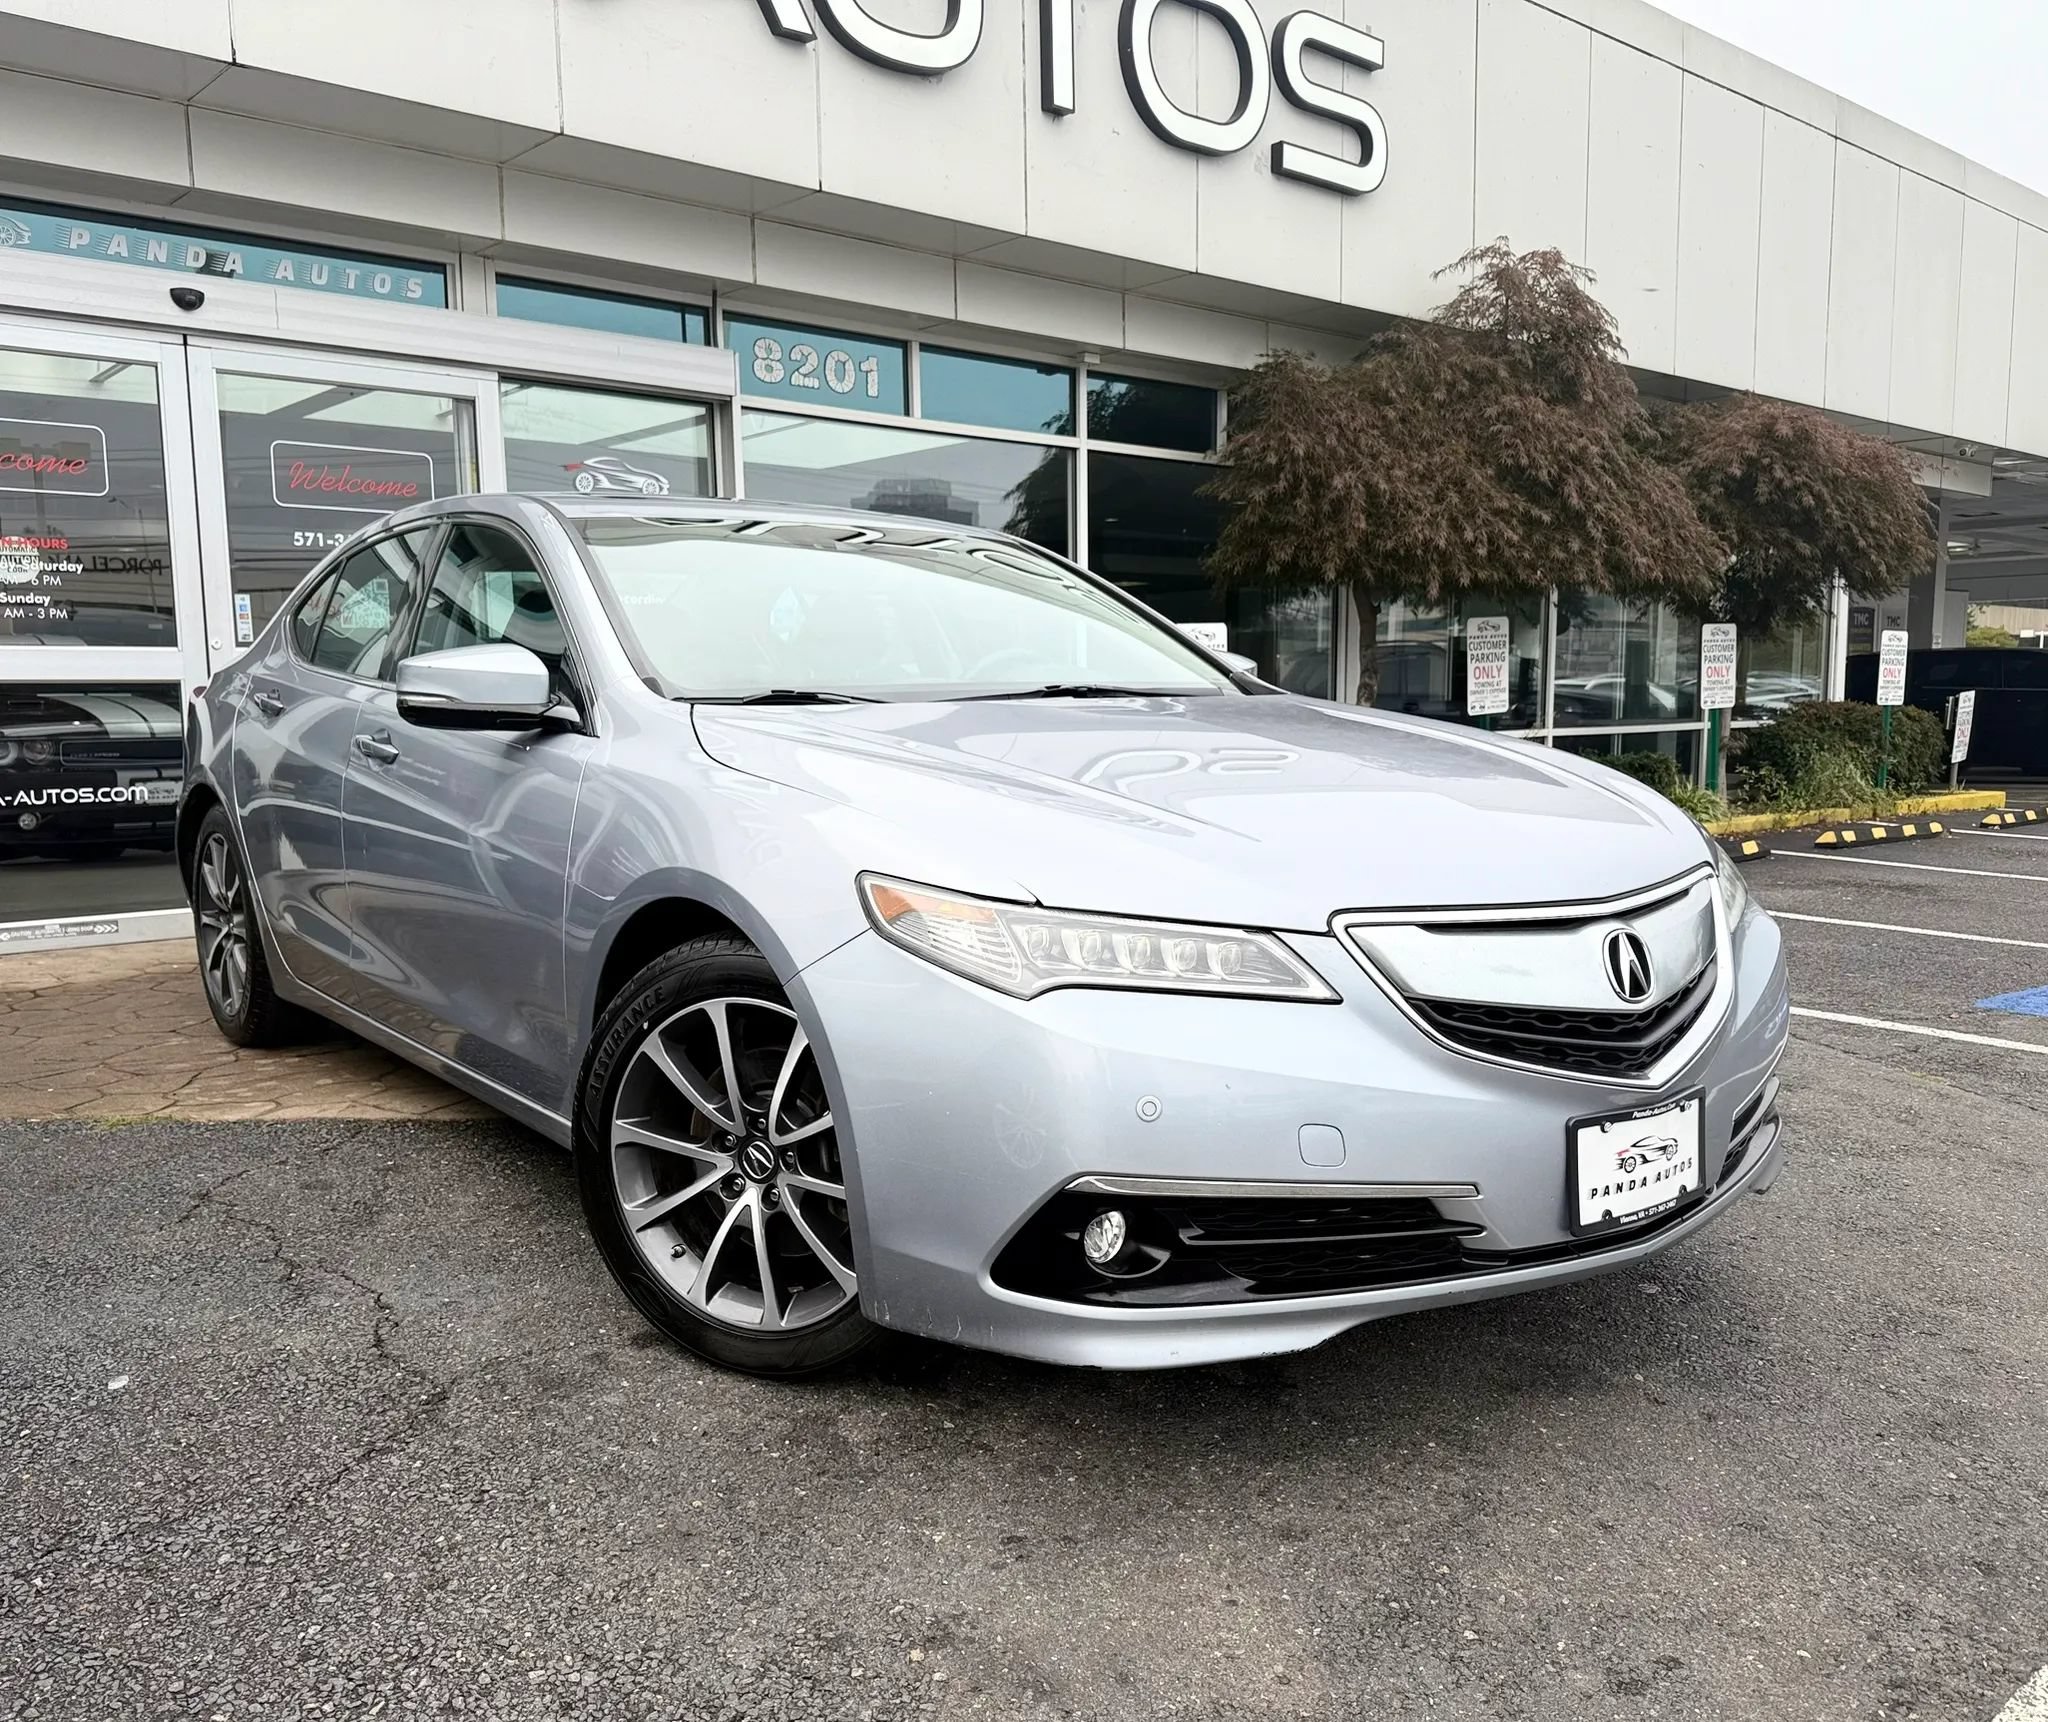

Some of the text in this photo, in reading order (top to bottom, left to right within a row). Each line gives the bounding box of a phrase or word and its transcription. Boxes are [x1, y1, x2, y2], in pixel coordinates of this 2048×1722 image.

[757, 0, 1388, 196] TOS
[68, 226, 424, 299] PANDA AUTOS
[752, 337, 880, 398] 8201
[288, 461, 419, 497] Welcome
[293, 531, 350, 547] 571-3
[31, 576, 39, 586] 6
[43, 575, 62, 586] PM
[0, 592, 51, 607] Sunday
[4, 608, 25, 619] AM
[37, 608, 45, 619] 3
[50, 608, 69, 619] PM
[1469, 640, 1507, 652] CUSTOMER
[1703, 643, 1735, 654] CUSTOMER
[1470, 651, 1506, 664] PARKING
[1704, 653, 1734, 664] PARKING
[1881, 657, 1905, 667] PARKING
[1473, 664, 1503, 680] ONLY
[1706, 665, 1731, 679] ONLY
[1882, 667, 1902, 679] ONLY
[1589, 1157, 1692, 1200] PANDA AUTOS
